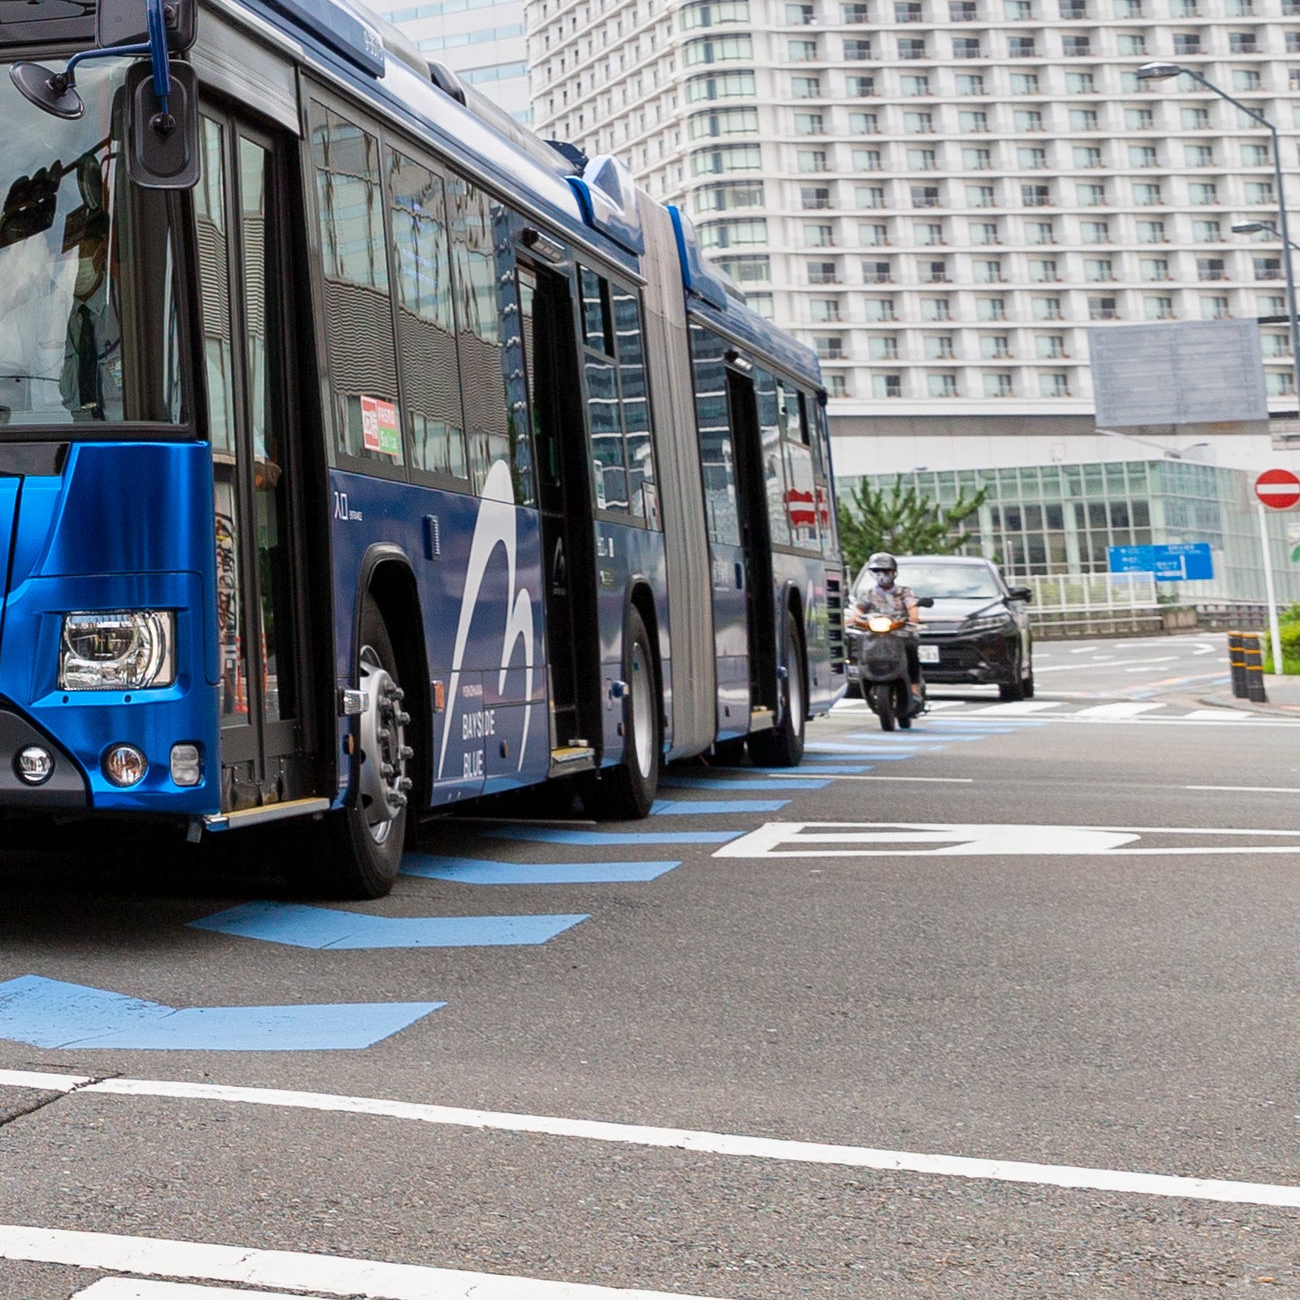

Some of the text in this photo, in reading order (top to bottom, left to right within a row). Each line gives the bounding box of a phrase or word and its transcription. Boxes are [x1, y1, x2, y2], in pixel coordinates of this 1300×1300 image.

[334, 491, 349, 521] 入口
[462, 710, 496, 740] BAYSIDE
[463, 749, 484, 779] BLUE
